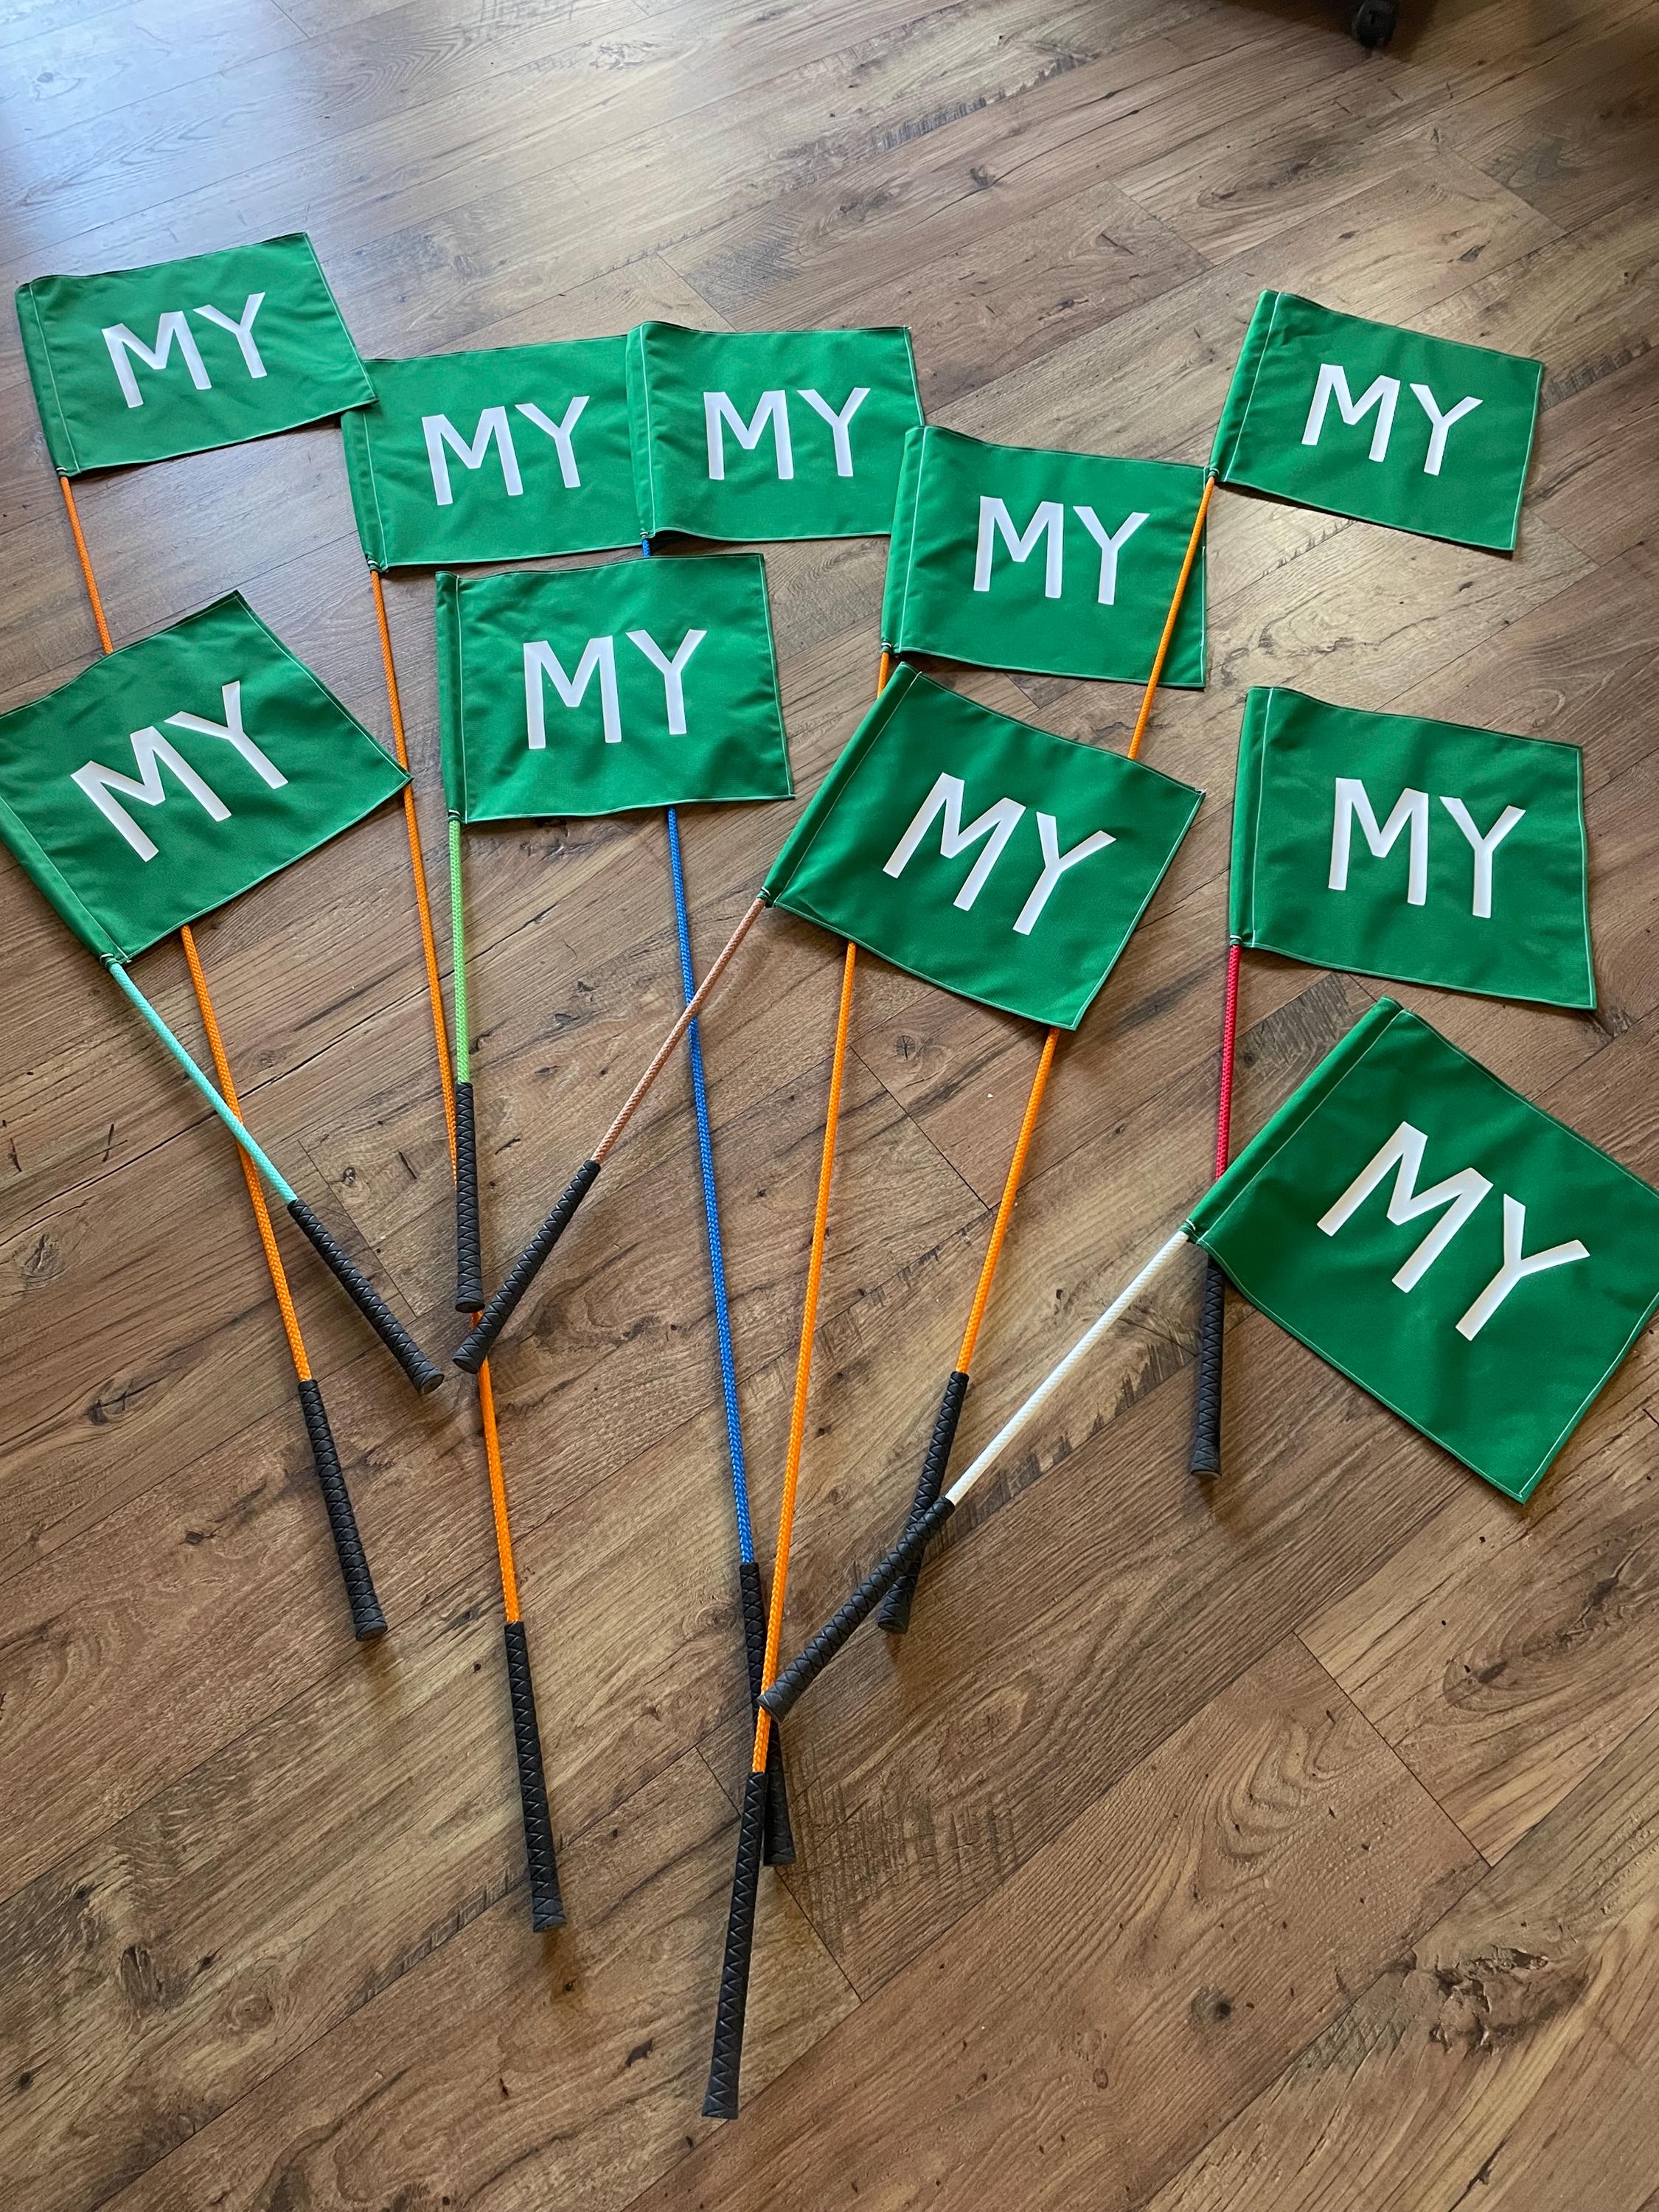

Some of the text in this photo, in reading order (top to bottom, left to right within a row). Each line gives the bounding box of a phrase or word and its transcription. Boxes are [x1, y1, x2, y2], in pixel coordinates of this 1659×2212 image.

[102, 292, 267, 408] MY
[422, 396, 590, 506] MY
[703, 387, 870, 480] MY
[1301, 363, 1483, 476] MY
[973, 495, 1150, 605] MY
[523, 629, 706, 749] MY
[70, 681, 288, 863] MY
[882, 772, 1116, 936] MY
[1328, 777, 1526, 919] MY
[1316, 1121, 1590, 1341] MY
